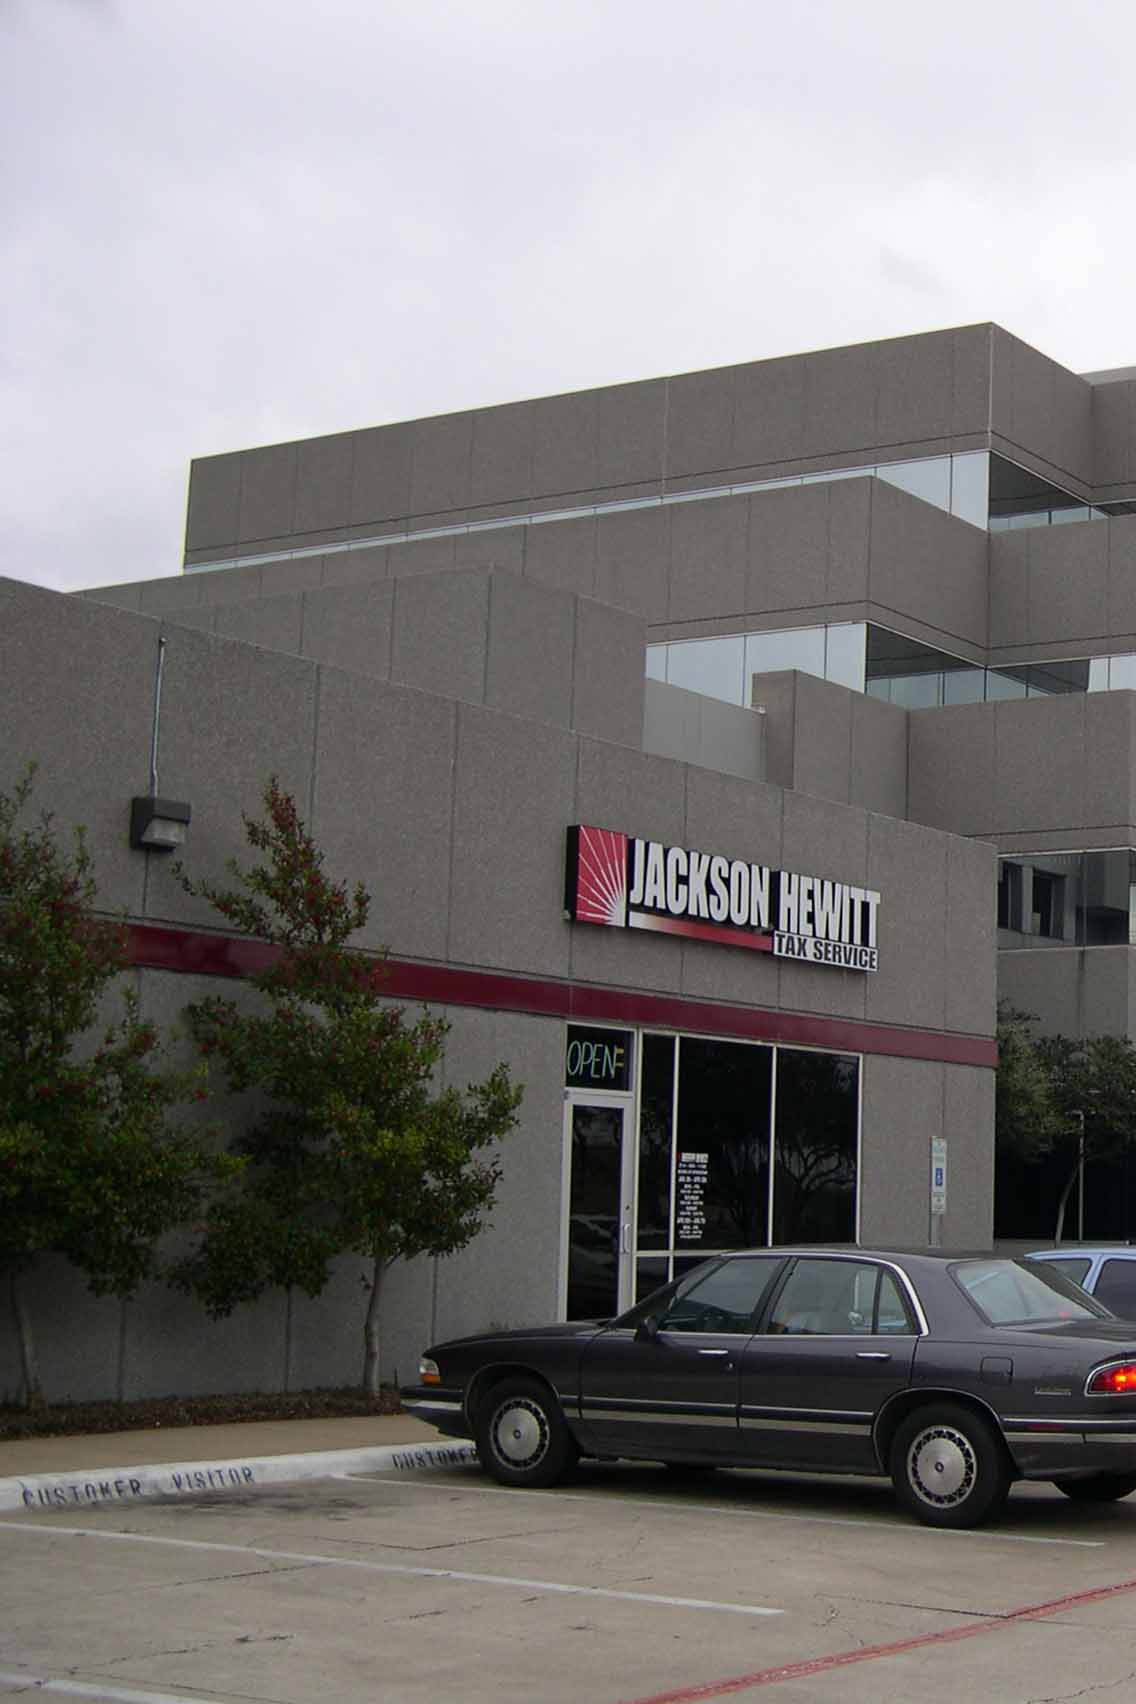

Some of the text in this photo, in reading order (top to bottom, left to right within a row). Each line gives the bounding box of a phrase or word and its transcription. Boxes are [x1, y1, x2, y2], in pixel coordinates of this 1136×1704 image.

[630, 838, 881, 947] JACKSON HEWITT
[775, 932, 877, 969] TAX SERVICE
[567, 1041, 616, 1079] OPEN
[21, 1466, 255, 1506] CUSTOMER VISITOR
